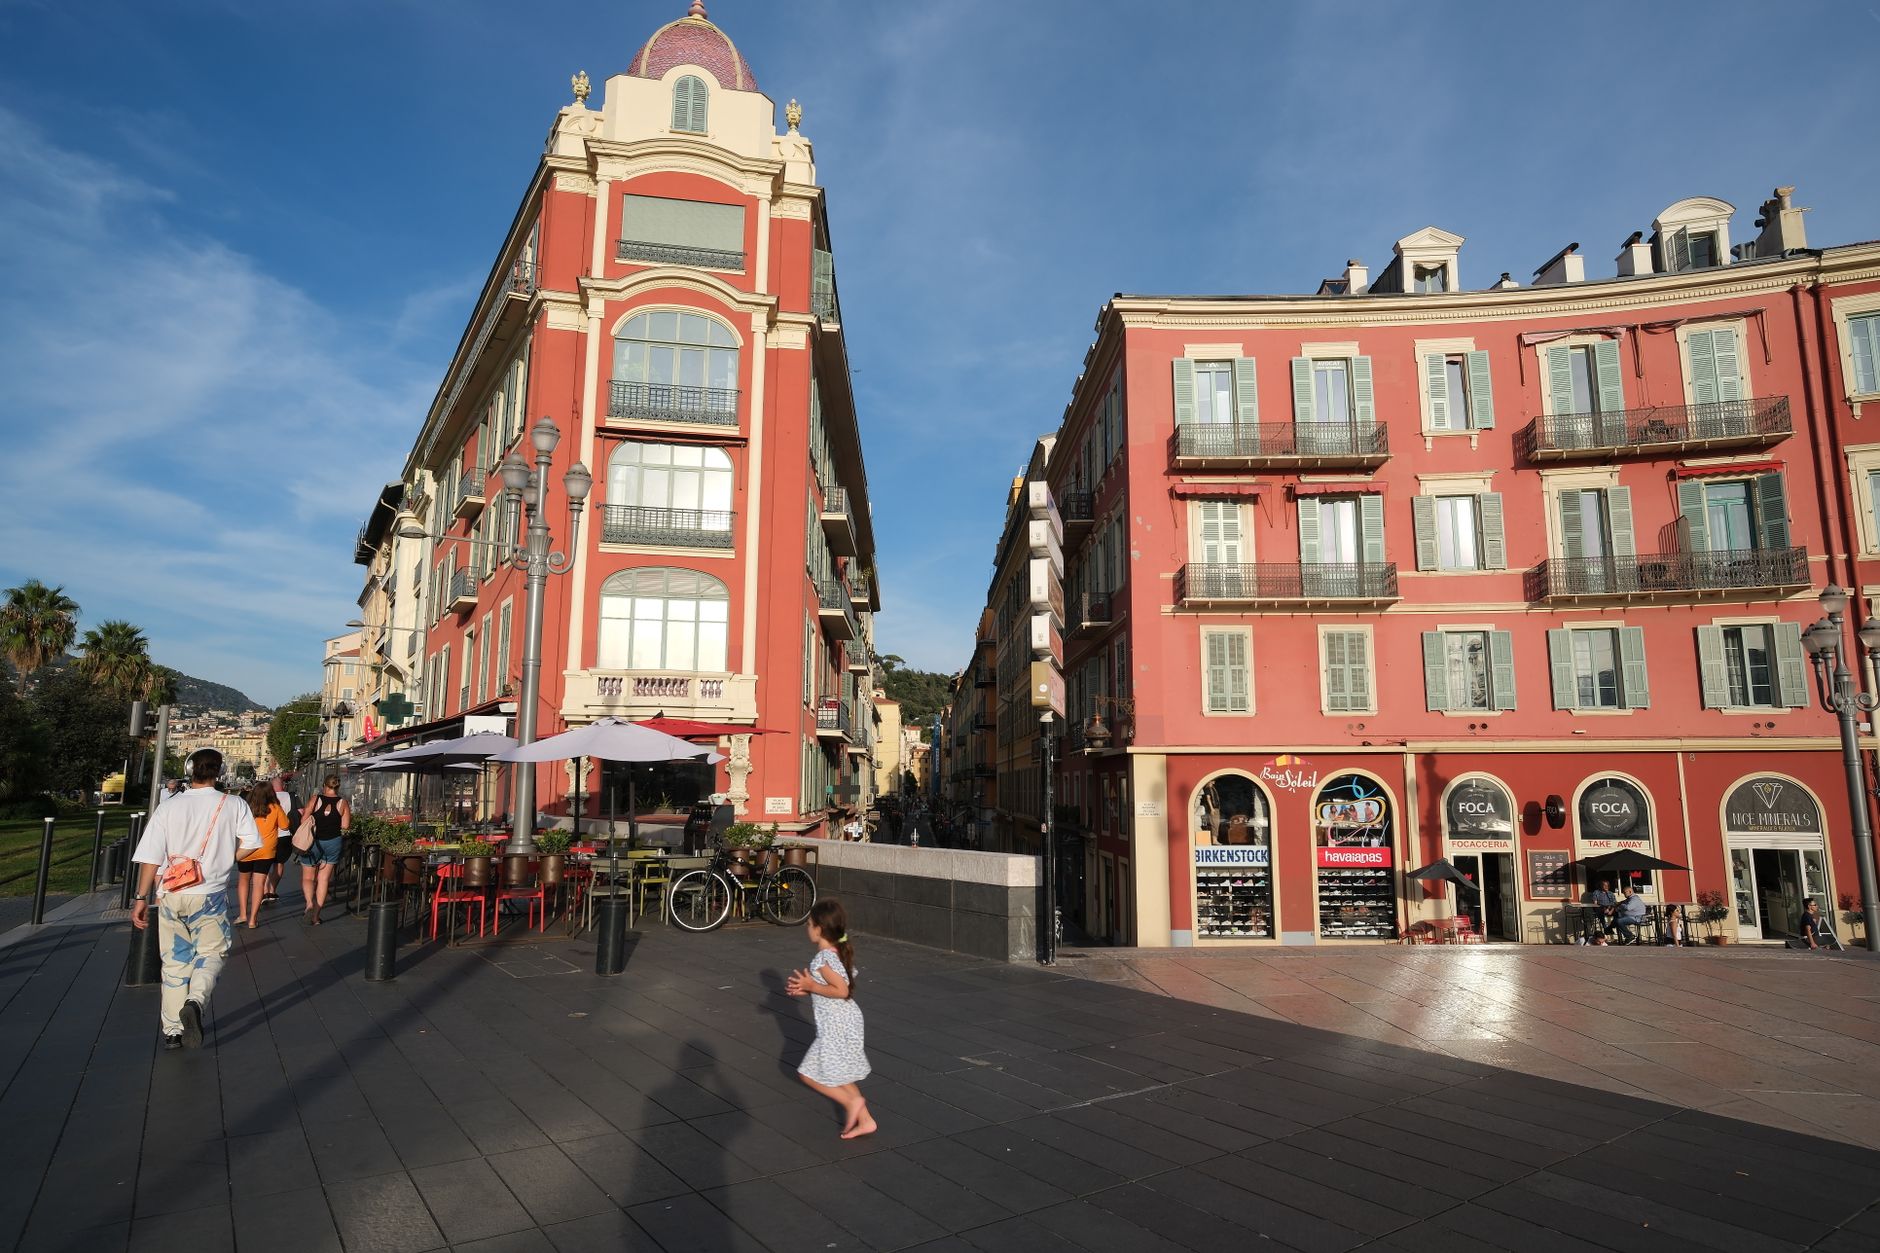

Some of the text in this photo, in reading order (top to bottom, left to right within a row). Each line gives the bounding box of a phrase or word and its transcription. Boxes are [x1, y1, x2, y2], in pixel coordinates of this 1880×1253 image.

[1260, 766, 1318, 788] Bain Soleil
[1459, 802, 1496, 813] FOCA
[1591, 802, 1631, 814] FOCA
[1732, 812, 1811, 827] NICE MINERALS
[1451, 840, 1509, 849] FOCACCERIA
[1588, 840, 1643, 848] TAKE AWAY
[1195, 849, 1268, 863] BIRKENSTOCK
[1325, 850, 1383, 865] havaianas
